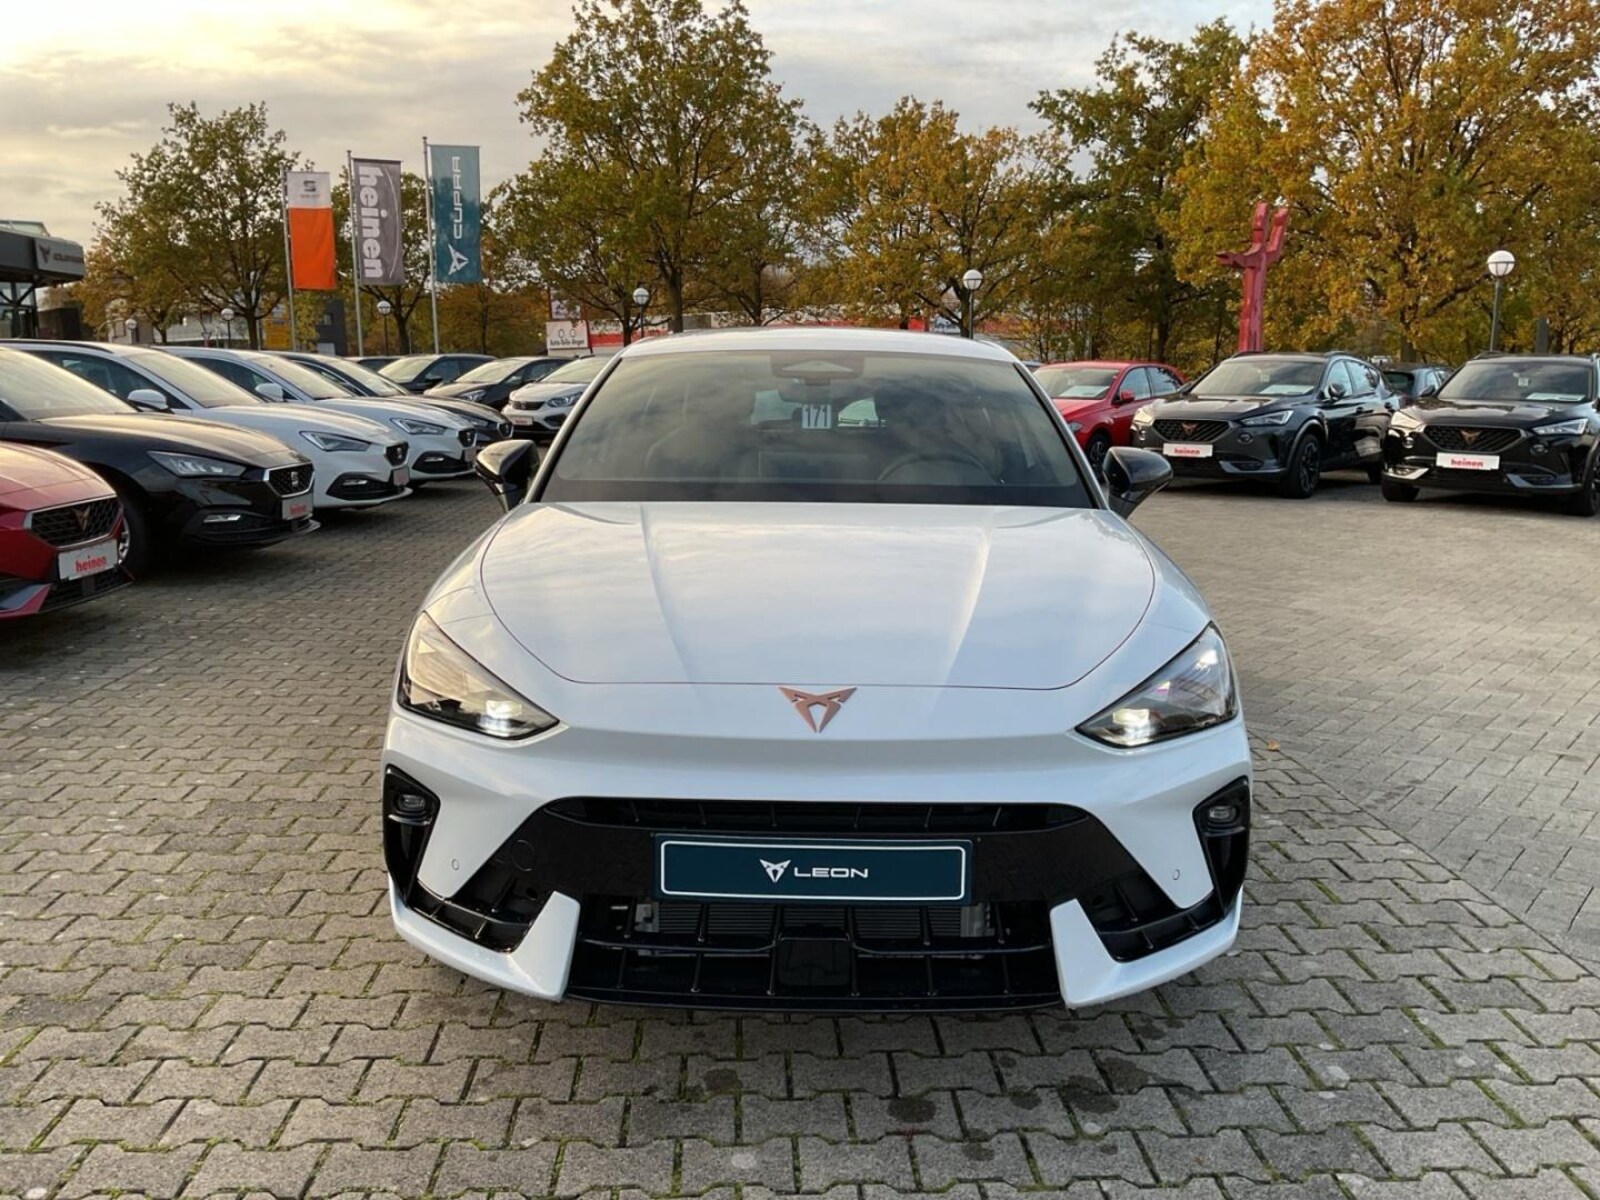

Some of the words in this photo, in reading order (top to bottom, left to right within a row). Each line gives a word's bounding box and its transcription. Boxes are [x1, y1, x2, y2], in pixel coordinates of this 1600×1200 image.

[451, 156, 463, 240] CUPRA
[359, 166, 388, 278] heinen
[804, 405, 828, 428] 171
[1450, 457, 1484, 467] heinen
[75, 555, 106, 572] heinen
[793, 866, 869, 879] LEON
